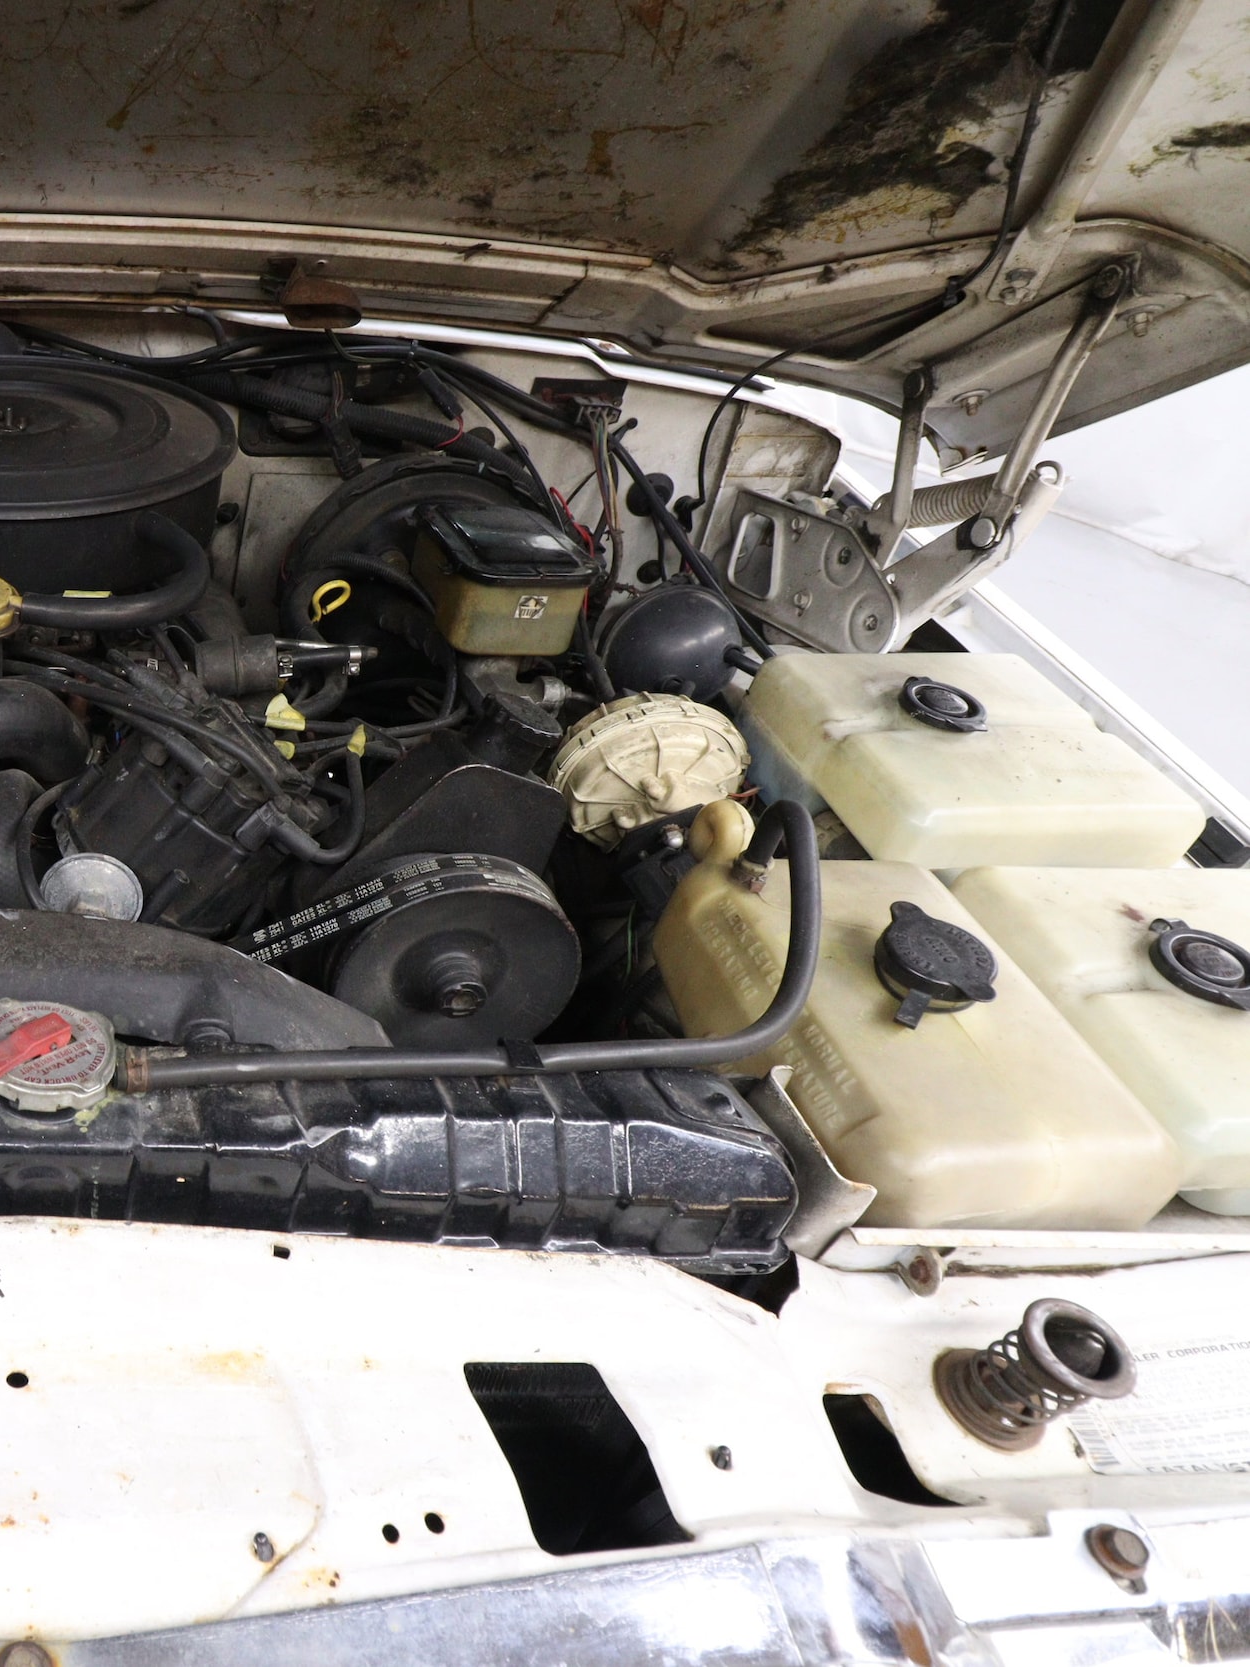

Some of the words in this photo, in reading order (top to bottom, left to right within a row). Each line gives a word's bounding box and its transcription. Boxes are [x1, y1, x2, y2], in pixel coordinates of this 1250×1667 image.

[292, 912, 316, 926] GATES
[73, 1042, 86, 1051] NOT
[54, 1048, 72, 1058] OPEN
[87, 1056, 101, 1071] LEVER
[19, 1065, 34, 1075] HOT
[78, 1069, 87, 1078] TO
[44, 1074, 77, 1084] UNLOCK
[1166, 1341, 1250, 1359] CORPORATIO
